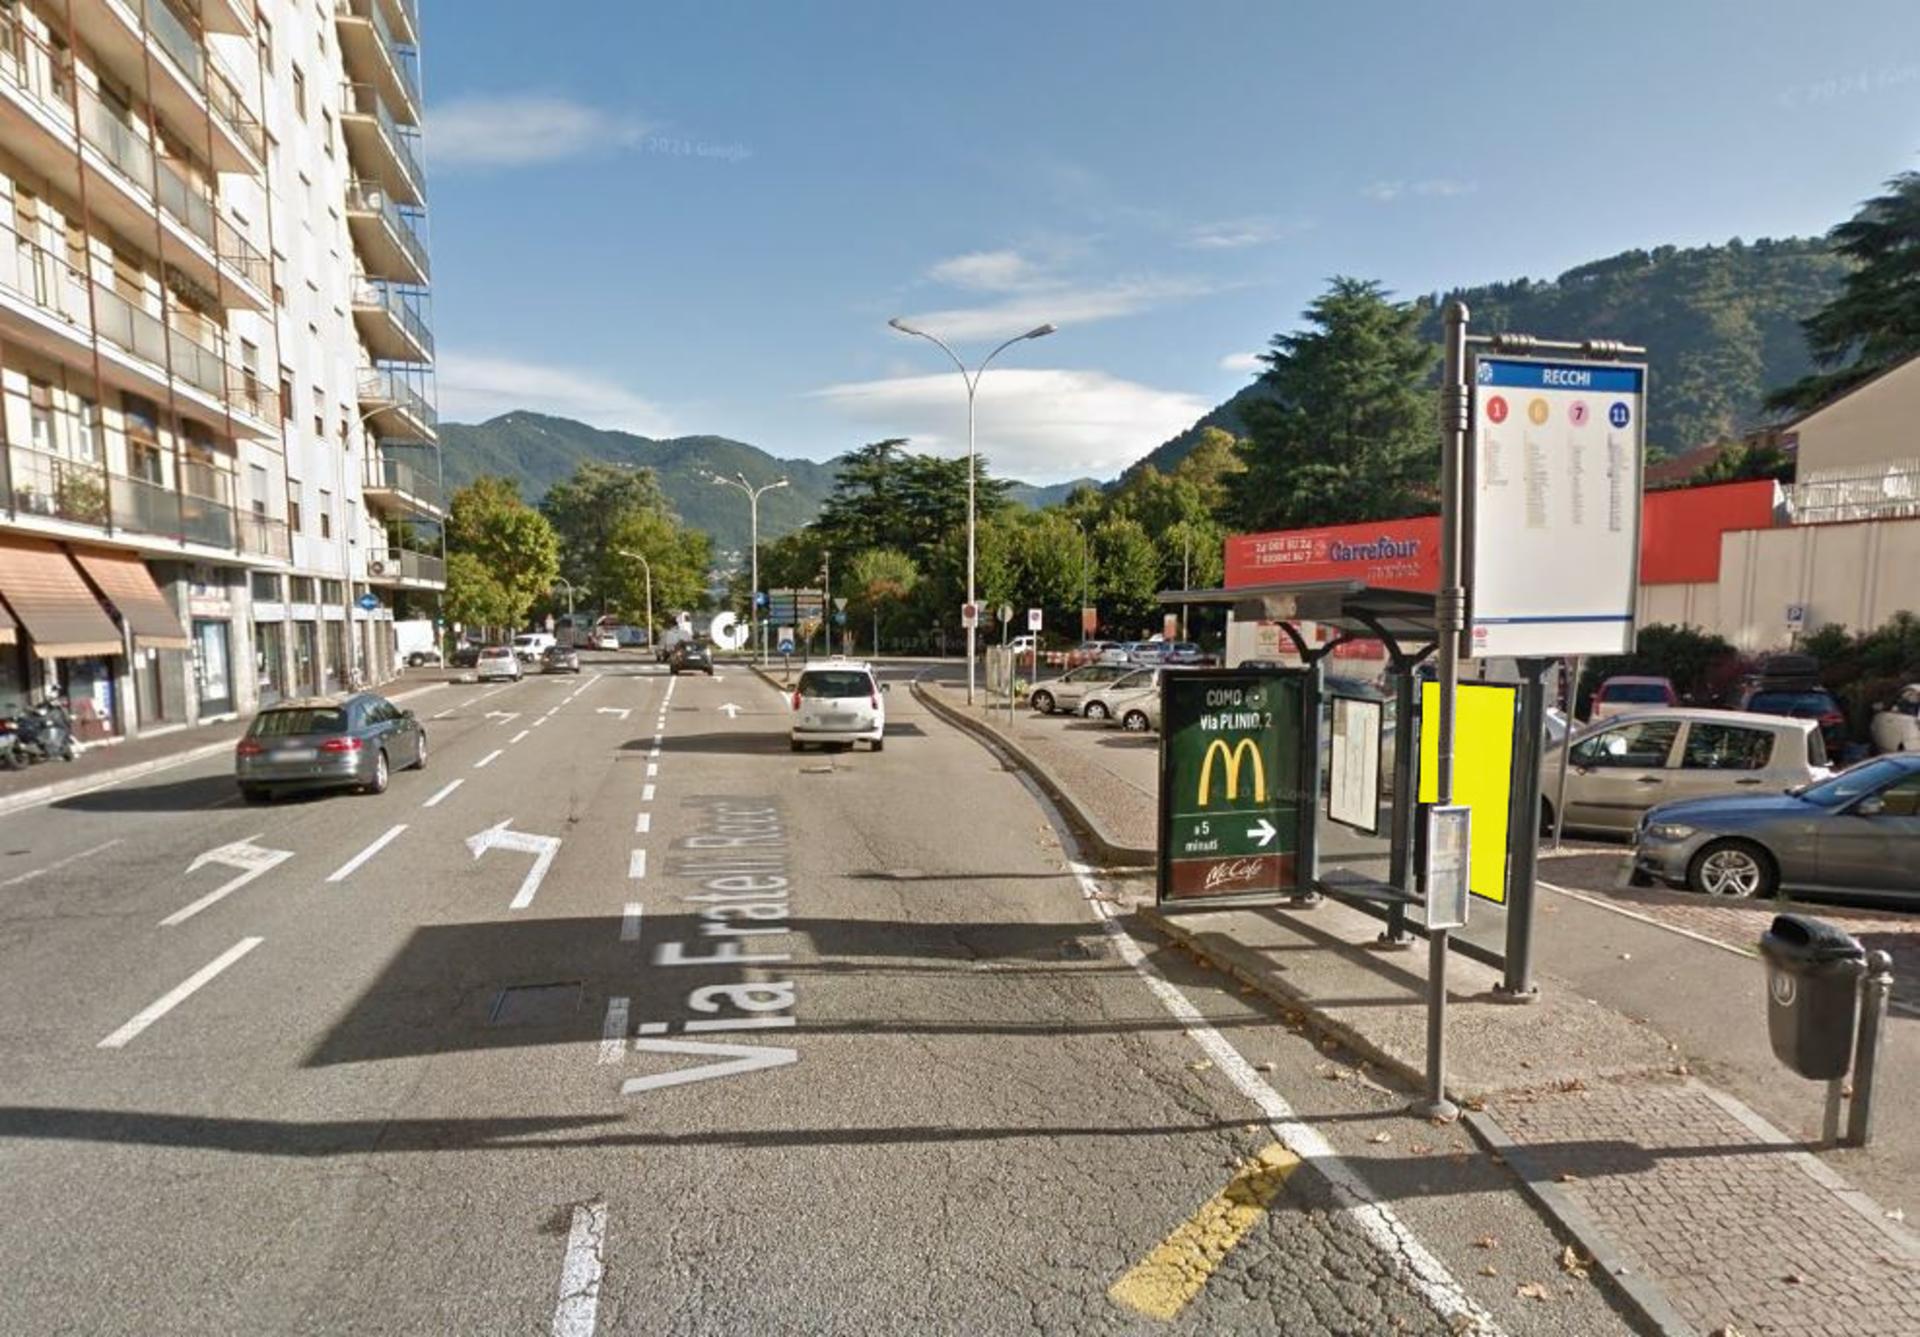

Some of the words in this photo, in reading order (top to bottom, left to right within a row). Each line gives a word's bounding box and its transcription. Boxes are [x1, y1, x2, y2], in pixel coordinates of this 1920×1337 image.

[1542, 368, 1591, 387] RECCHI
[1493, 402, 1501, 418] 1
[1574, 406, 1584, 421] 7
[1612, 408, 1627, 423] 11
[1330, 537, 1417, 561] Carrefour
[1206, 689, 1242, 706] COMO
[1200, 713, 1218, 731] Via
[1265, 711, 1273, 728] 2
[1201, 820, 1210, 835] 5
[1185, 839, 1218, 852] minuti
